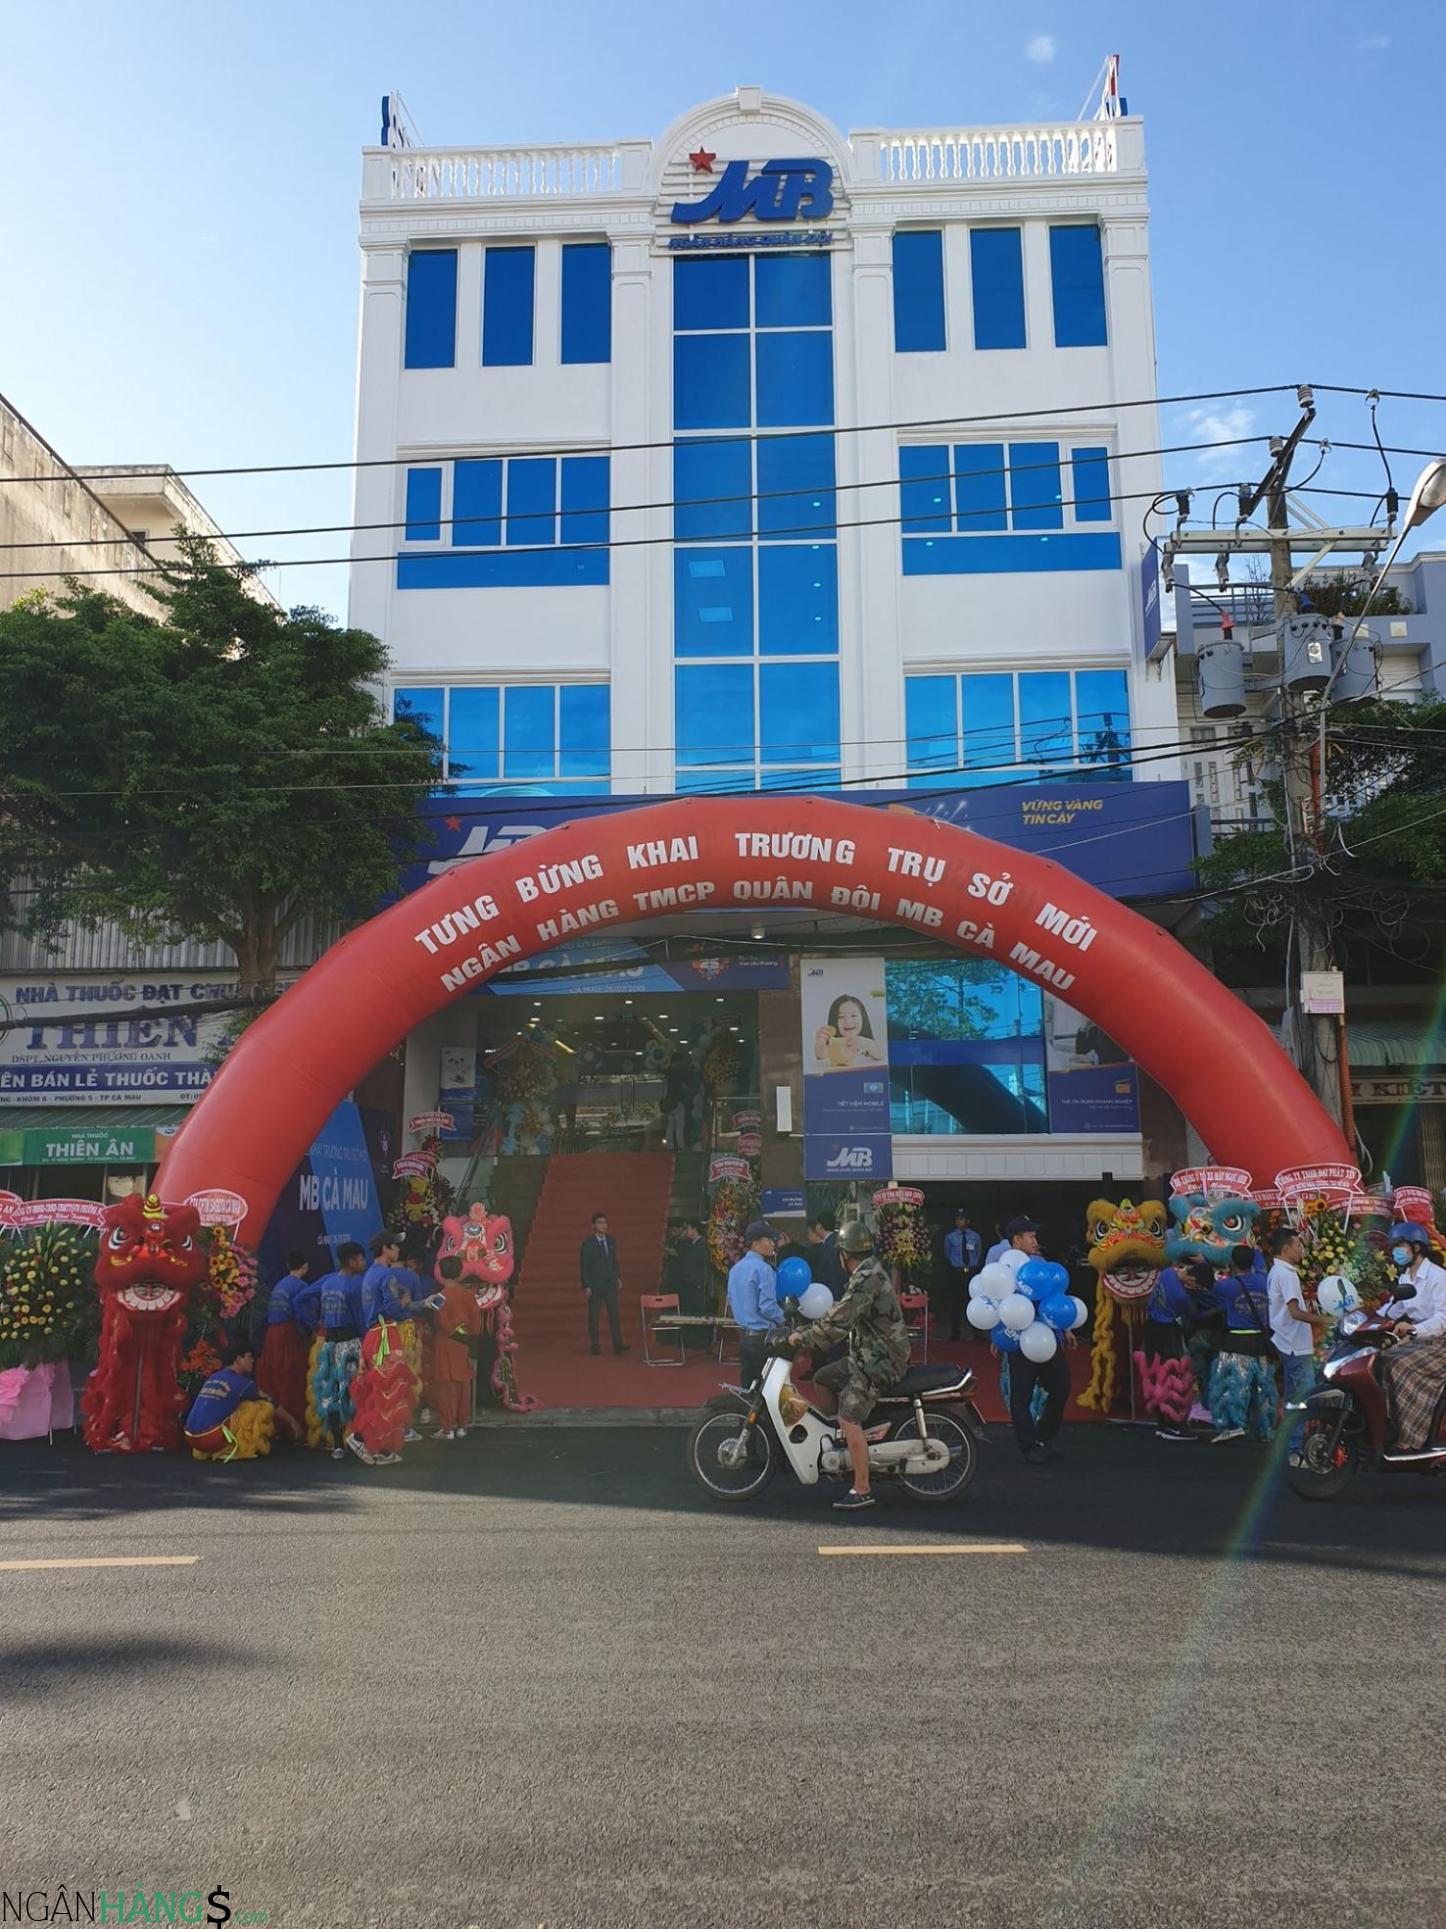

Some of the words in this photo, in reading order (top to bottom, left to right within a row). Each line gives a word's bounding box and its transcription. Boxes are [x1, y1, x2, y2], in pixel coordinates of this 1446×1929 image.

[671, 158, 834, 224] MB
[1064, 798, 1104, 811] VÀNG
[1022, 813, 1046, 825] TIN
[414, 894, 500, 954] TƯNG
[514, 853, 604, 903] BỪNG
[627, 835, 699, 869] KHAI
[735, 831, 856, 865] TRƯƠNG
[888, 847, 946, 887] TRỤ
[968, 872, 1015, 906] SỞ
[1035, 902, 1098, 952] MỚI
[440, 934, 522, 992] NGÂN
[537, 898, 620, 942] HÀNG
[633, 881, 716, 911] TMCP
[733, 875, 813, 899] QUÂN
[831, 884, 881, 911] ĐỘI
[896, 898, 945, 927] MB
[956, 922, 995, 949] CÀ
[1009, 941, 1076, 992] MAU
[16, 982, 58, 1004] NHÀ
[65, 980, 137, 1002] THUỐC
[142, 983, 184, 1005] ĐẠT
[140, 1052, 171, 1061] OANH
[31, 1070, 71, 1087] BÁN
[75, 1067, 98, 1087] LẺ
[105, 1066, 169, 1086] THUỐC
[175, 1069, 220, 1086] THÀ
[46, 1138, 100, 1158] THIÊN
[106, 1137, 134, 1157] ÂN
[827, 1147, 872, 1168] MB
[299, 1176, 320, 1211] MB
[322, 1168, 341, 1211] CÀ
[344, 1177, 369, 1211] MAU
